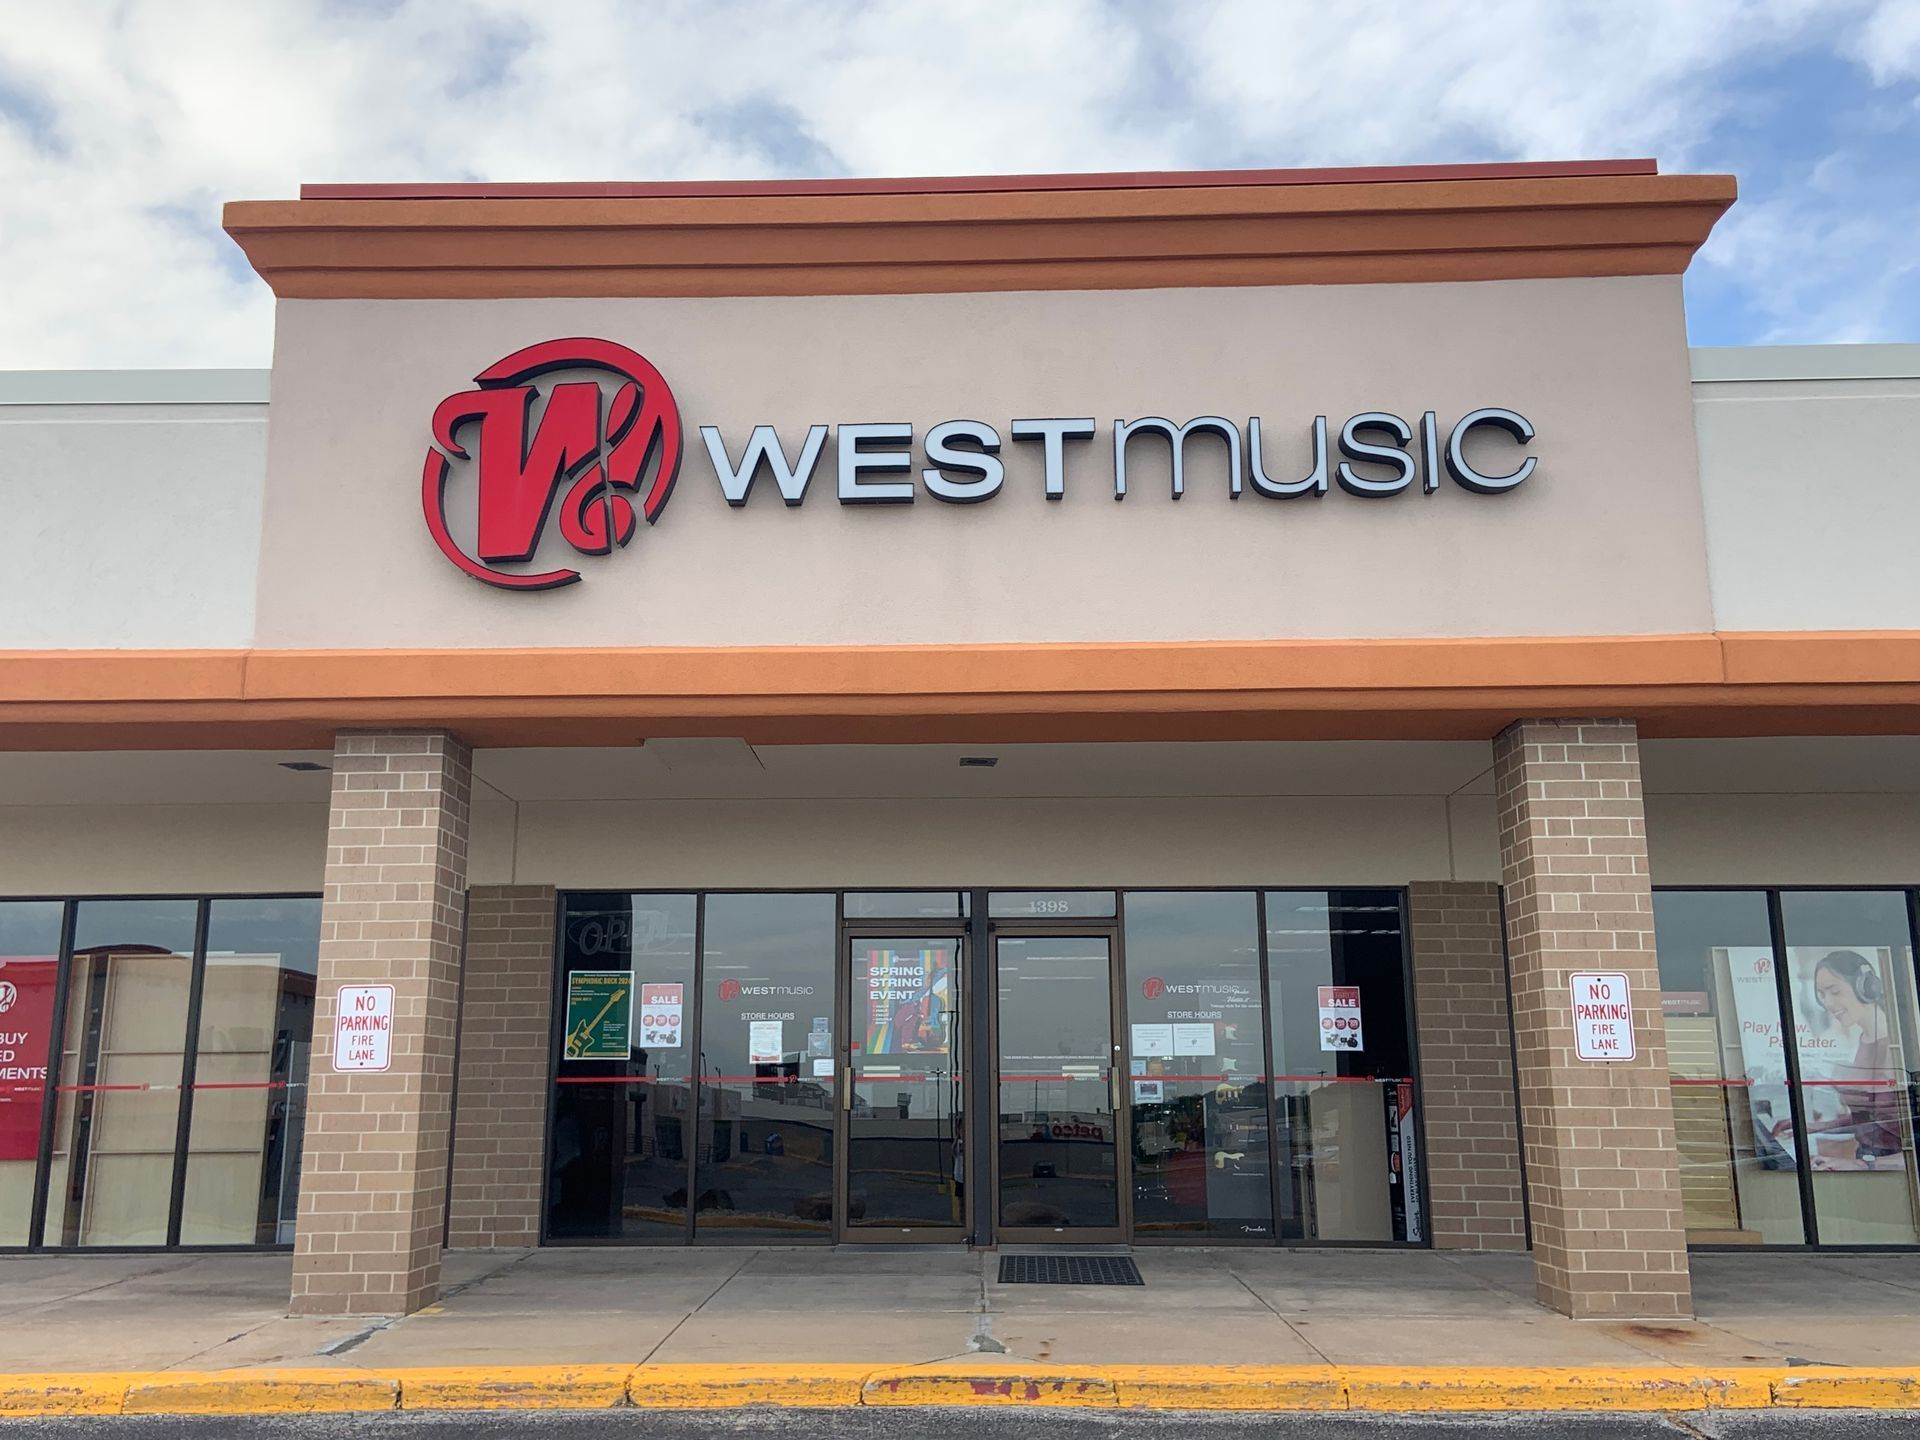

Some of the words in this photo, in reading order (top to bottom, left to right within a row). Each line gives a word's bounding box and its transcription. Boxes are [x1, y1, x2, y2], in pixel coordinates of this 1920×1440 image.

[1028, 900, 1069, 913] 1398
[870, 967, 924, 976] SPRING
[870, 978, 922, 988] STRING
[870, 991, 915, 1000] EVENT
[1589, 984, 1611, 1000] NO
[356, 996, 375, 1011] NO
[1328, 999, 1356, 1007] SALE
[741, 1012, 766, 1020] STORE
[768, 1012, 795, 1020] HOURS
[1167, 1011, 1192, 1019] STORE
[1194, 1011, 1222, 1019] HOURS
[1577, 1004, 1627, 1020] PARKING
[341, 1015, 388, 1031] PARKING
[1743, 1021, 1771, 1035] Play
[1592, 1024, 1616, 1035] FIRE
[352, 1035, 374, 1046] FIRE
[1591, 1039, 1619, 1049] LANE
[1800, 1036, 1837, 1048] Later.
[0, 1050, 15, 1063] D
[349, 1049, 375, 1060] LANE
